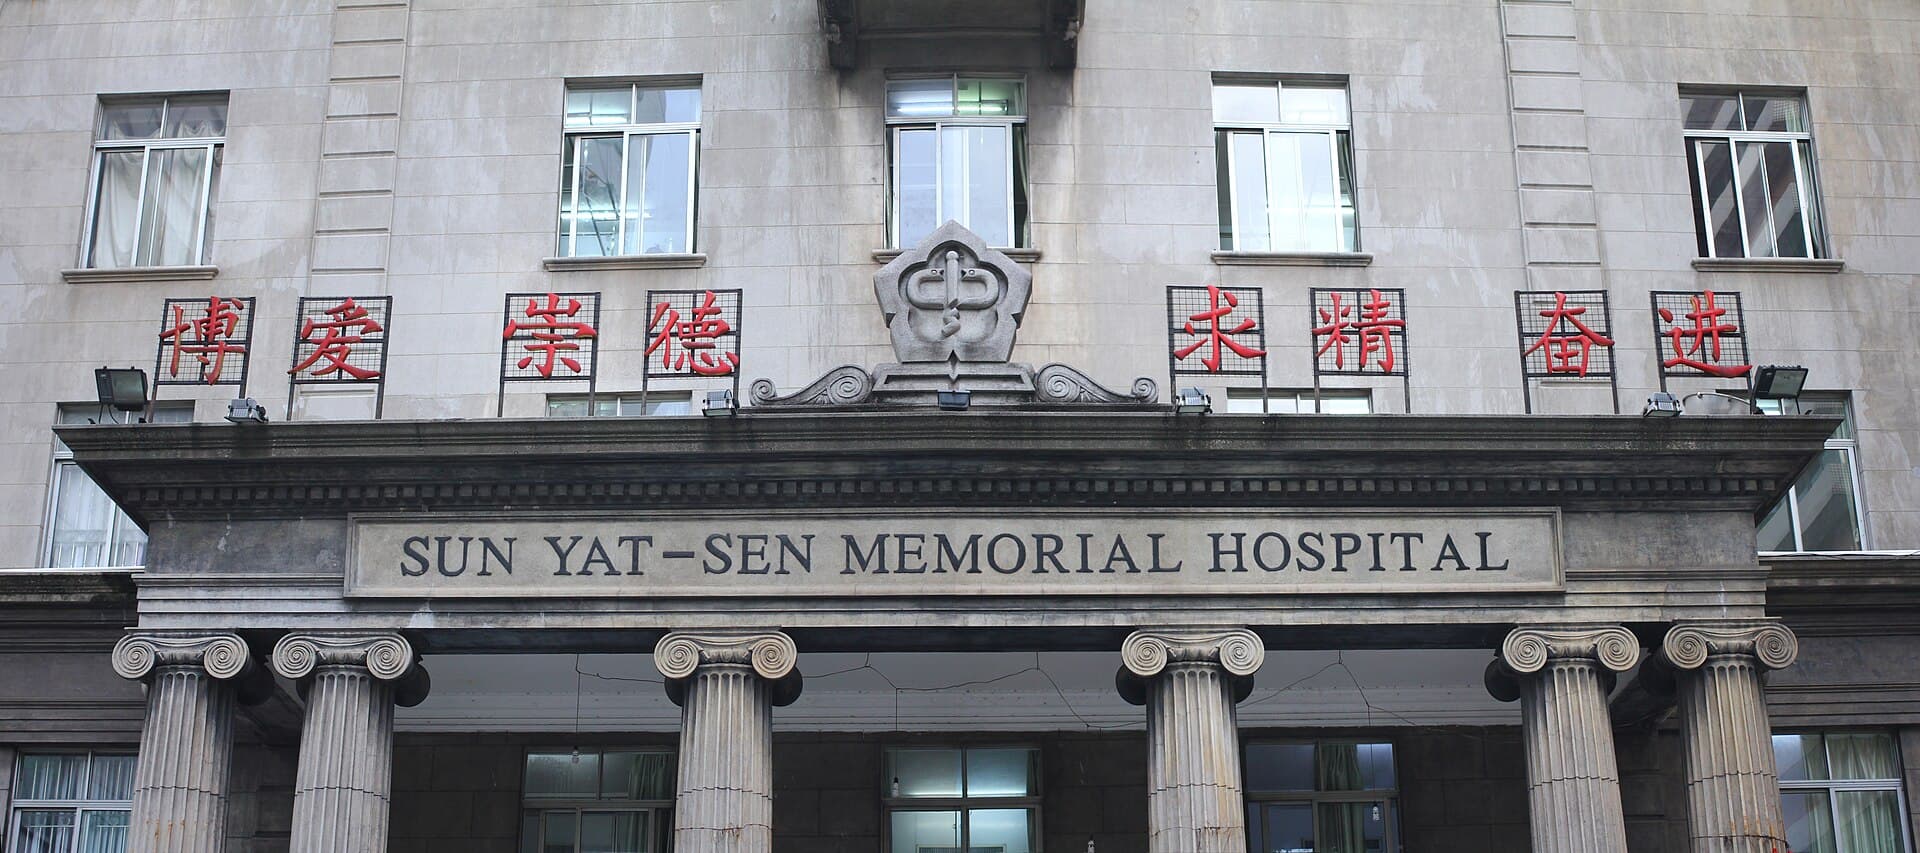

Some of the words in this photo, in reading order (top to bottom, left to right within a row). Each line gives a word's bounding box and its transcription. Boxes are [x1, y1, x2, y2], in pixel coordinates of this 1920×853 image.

[160, 295, 381, 385] 博爱
[502, 292, 739, 377] 崇德
[1173, 285, 1405, 374] 求精
[1524, 289, 1752, 378] 奋进
[400, 535, 517, 577] SUN
[840, 532, 1182, 575] MEMORIAL
[1208, 531, 1509, 573] HOSPITAL
